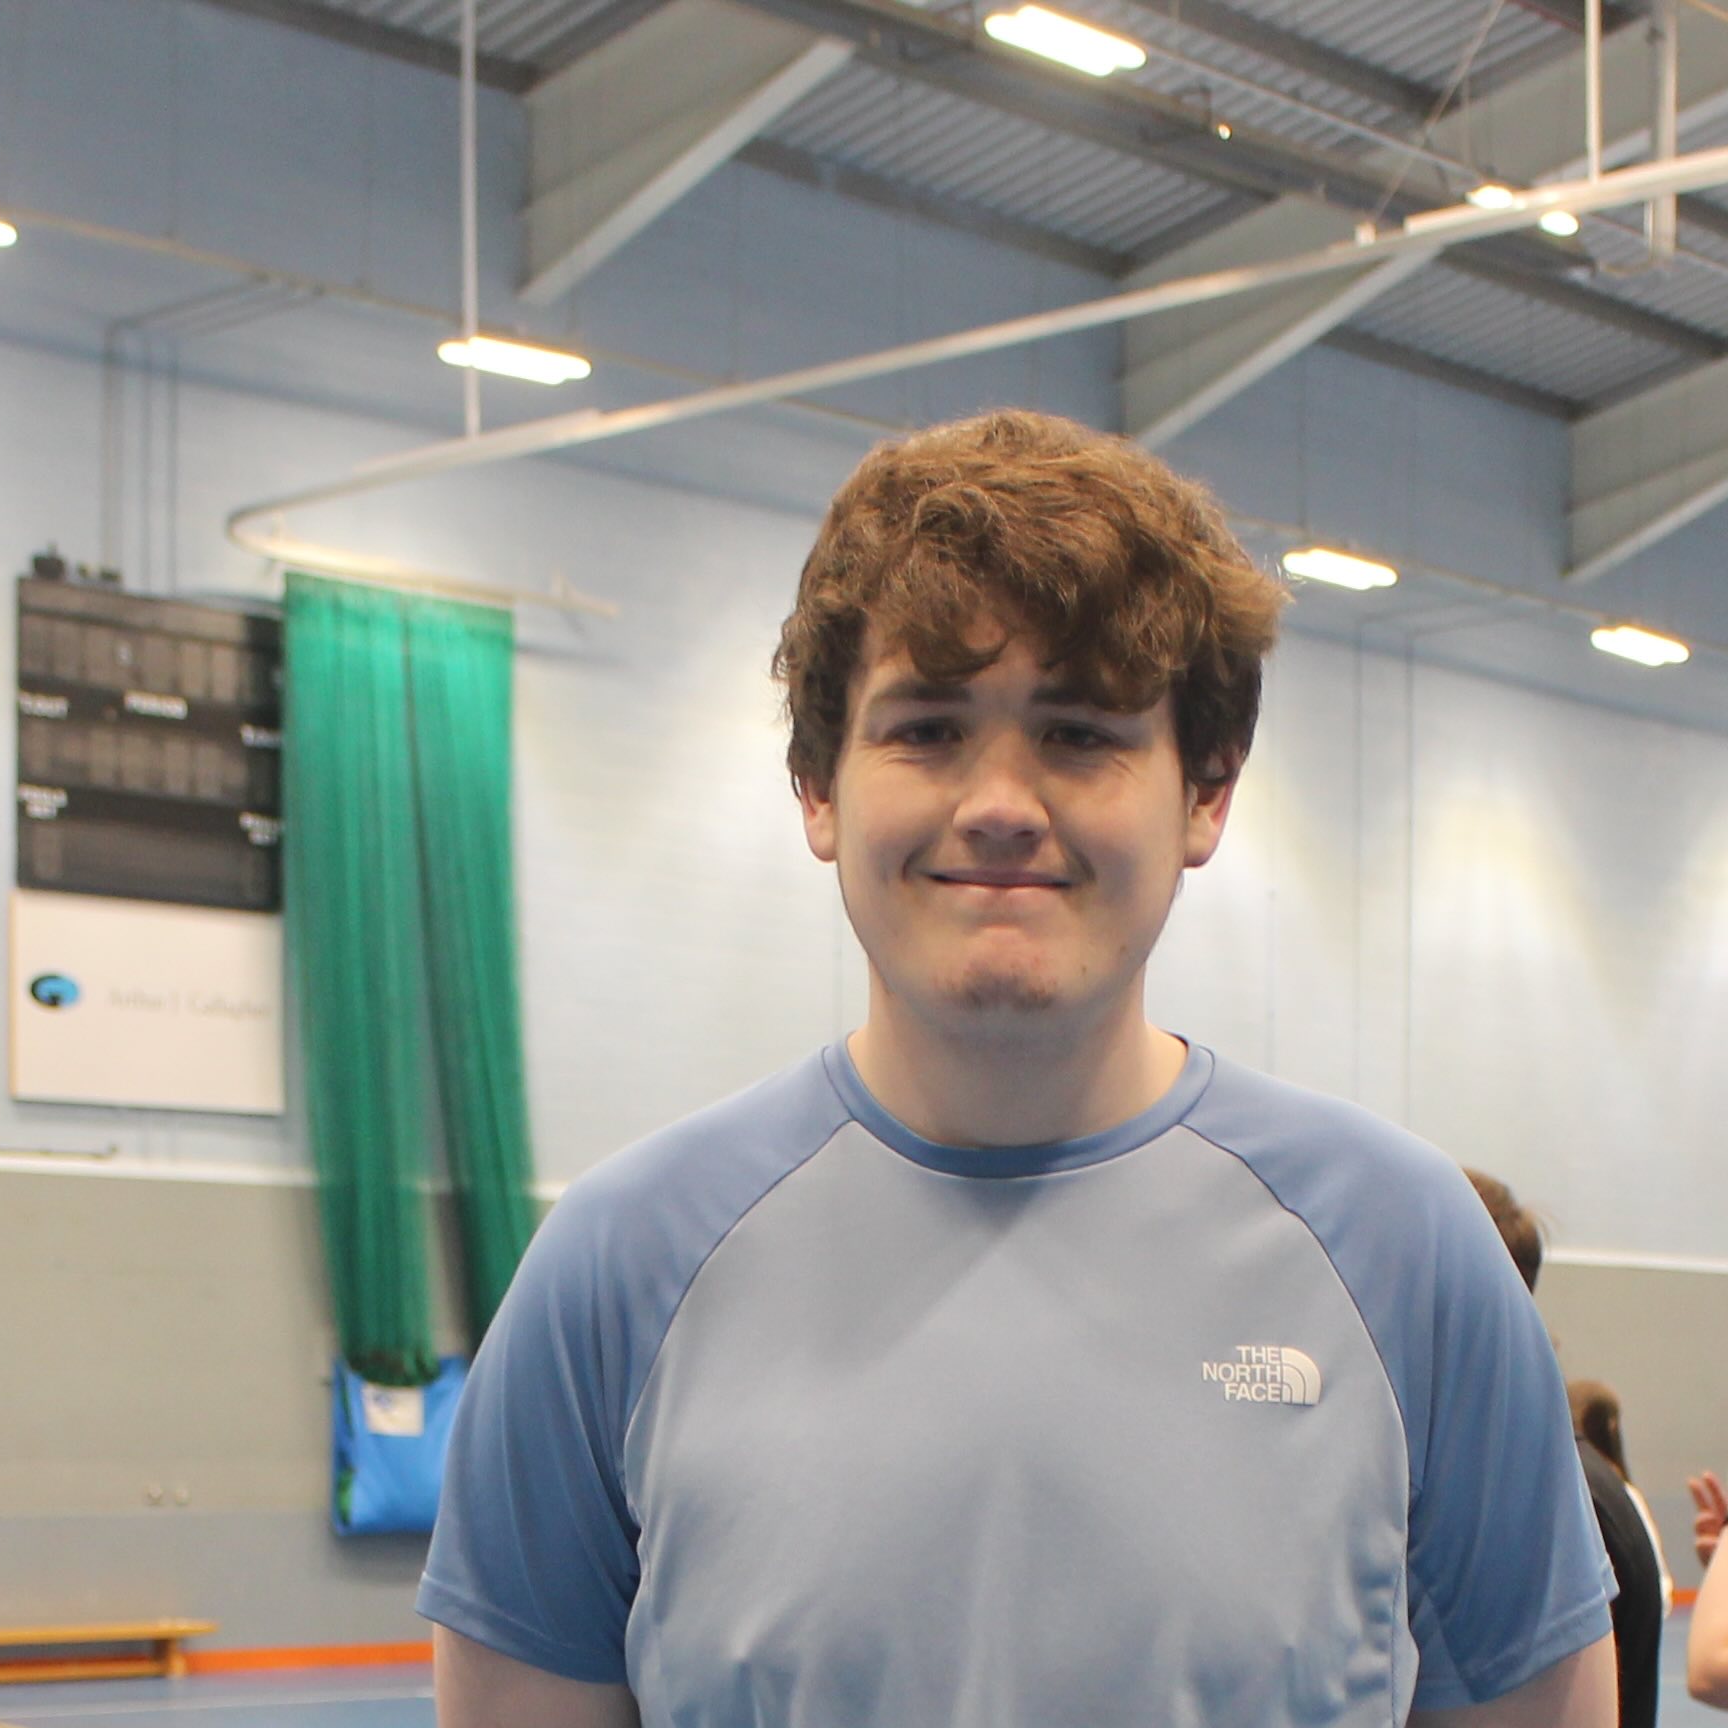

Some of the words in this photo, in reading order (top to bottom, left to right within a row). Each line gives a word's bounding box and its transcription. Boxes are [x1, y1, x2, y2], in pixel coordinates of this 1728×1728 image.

[1235, 1345, 1280, 1364] THE
[1202, 1362, 1281, 1382] NORTH
[1224, 1382, 1281, 1402] FACE
